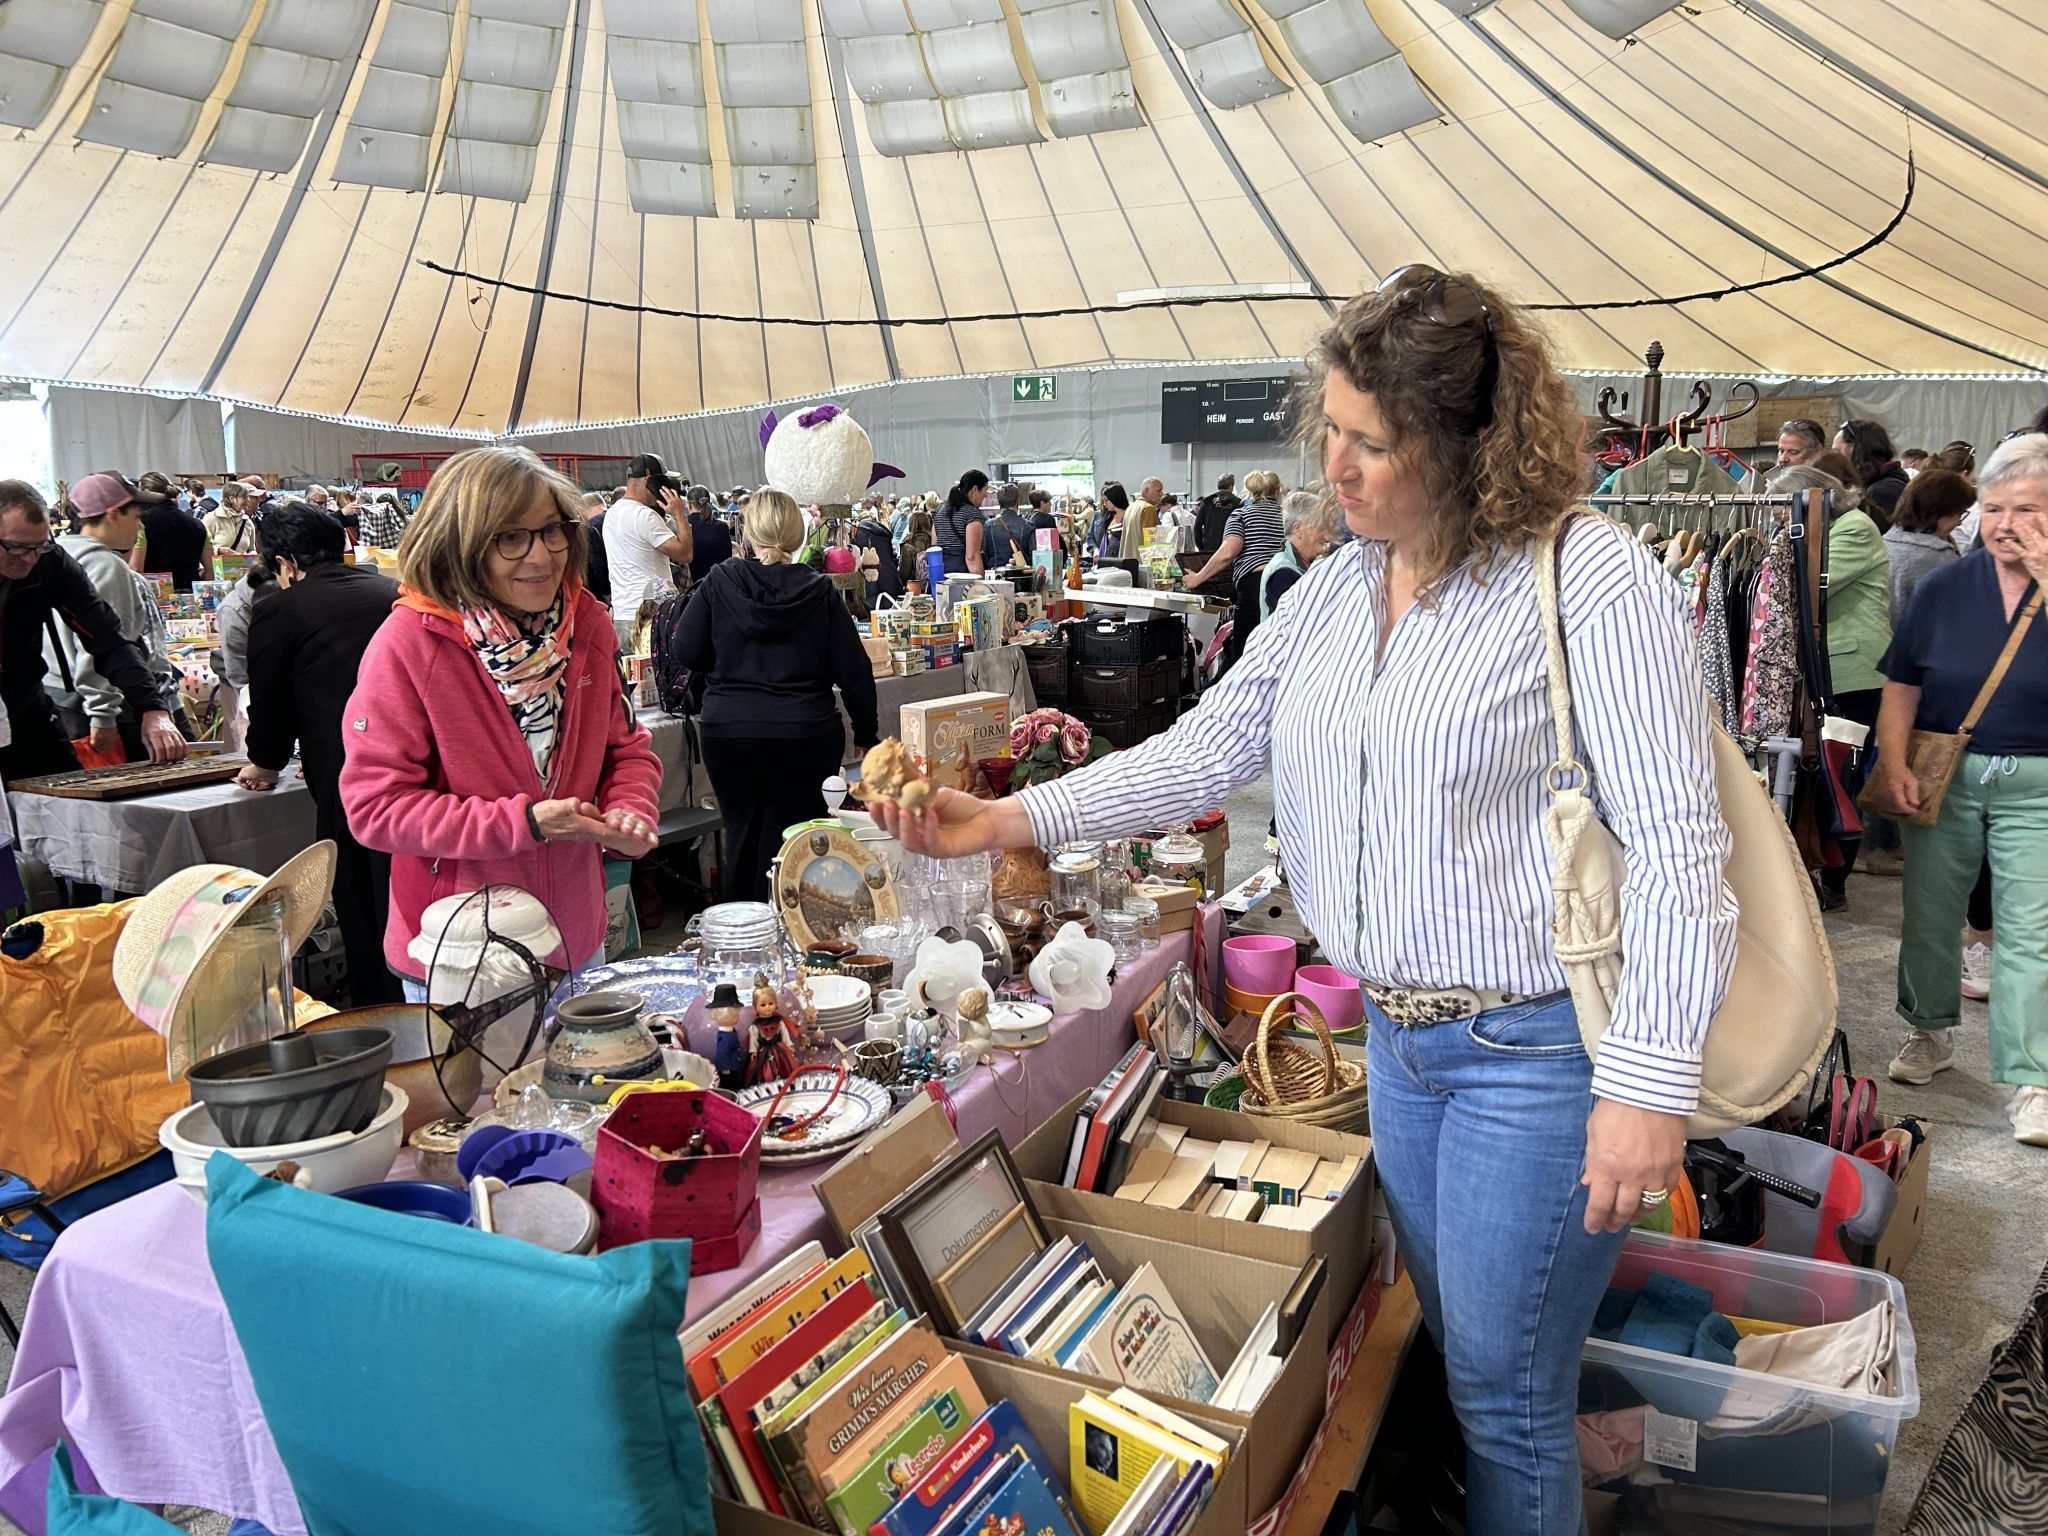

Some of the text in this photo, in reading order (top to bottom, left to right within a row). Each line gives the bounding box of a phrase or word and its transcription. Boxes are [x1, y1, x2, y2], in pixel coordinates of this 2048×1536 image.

[1206, 414, 1227, 423] HEIM
[1262, 411, 1286, 421] GAST
[973, 722, 1006, 740] FORM
[941, 1207, 1001, 1263] Dokumenten-
[828, 1400, 878, 1453] GRIMM'S
[874, 1355, 930, 1412] MÄRCHEN
[904, 1432, 946, 1479] Leserabe
[950, 1432, 988, 1474] Kinderbuch
